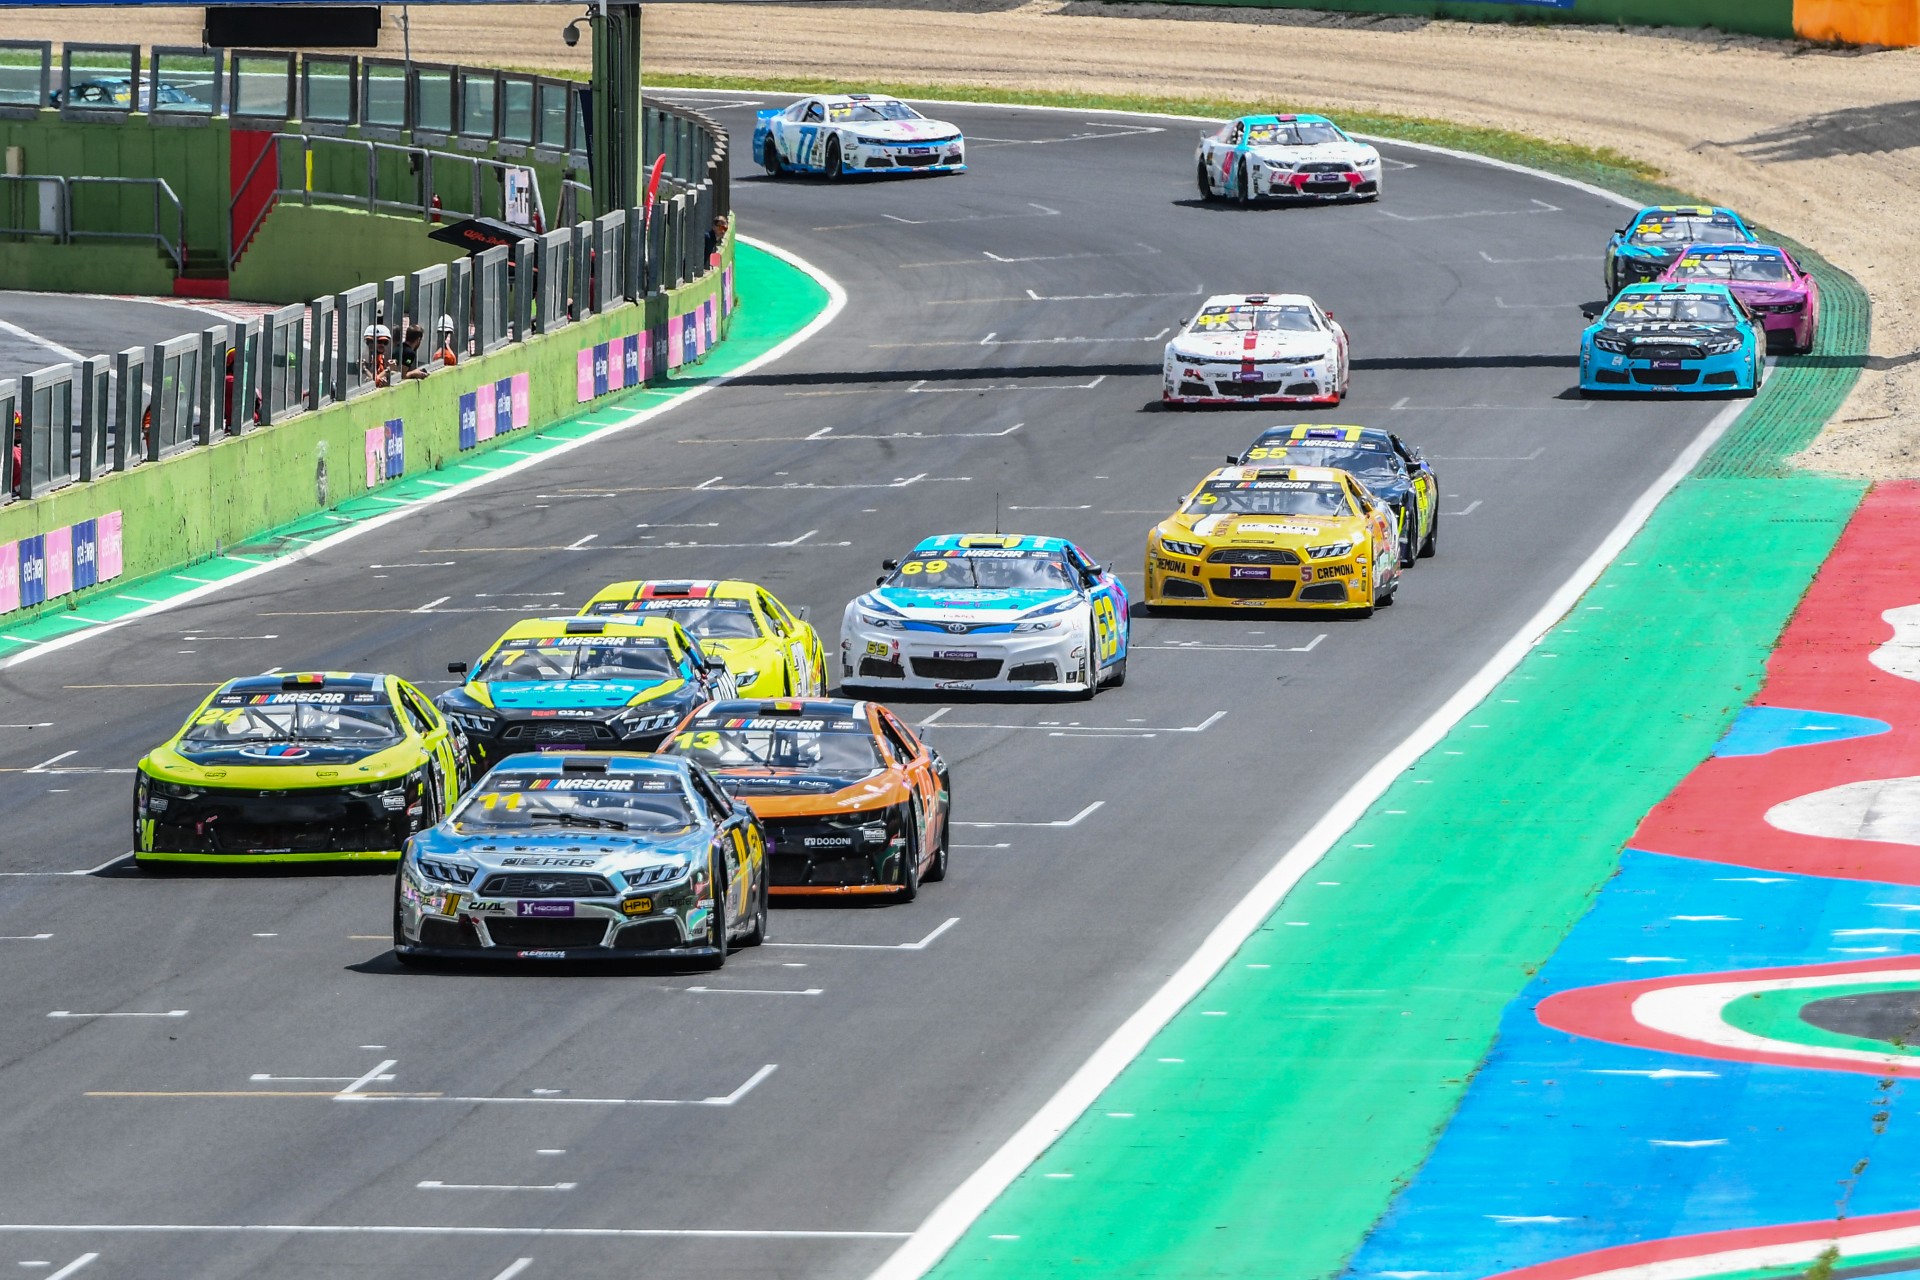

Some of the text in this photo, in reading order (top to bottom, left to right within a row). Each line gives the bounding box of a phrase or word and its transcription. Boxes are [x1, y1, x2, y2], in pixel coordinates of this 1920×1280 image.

[1301, 439, 1356, 449] NASCAR
[1246, 447, 1289, 460] 55
[1255, 481, 1311, 489] NASCAR
[1199, 492, 1218, 505] 5
[962, 549, 1025, 558] NASCAR
[901, 560, 948, 575] 69
[1316, 563, 1355, 579] CREMONA
[1300, 566, 1313, 582] 5
[647, 599, 711, 610] NASCAR
[560, 636, 627, 646] NASCAR
[867, 640, 889, 656] 69
[502, 650, 526, 666] 7
[275, 692, 345, 704] NASCAR
[196, 707, 245, 725] 24
[749, 718, 825, 730] NASCAR
[674, 731, 721, 749] 13
[557, 779, 634, 791] NASCAR
[478, 792, 522, 811] 11
[816, 837, 851, 846] DODONI
[624, 900, 650, 911] HPM
